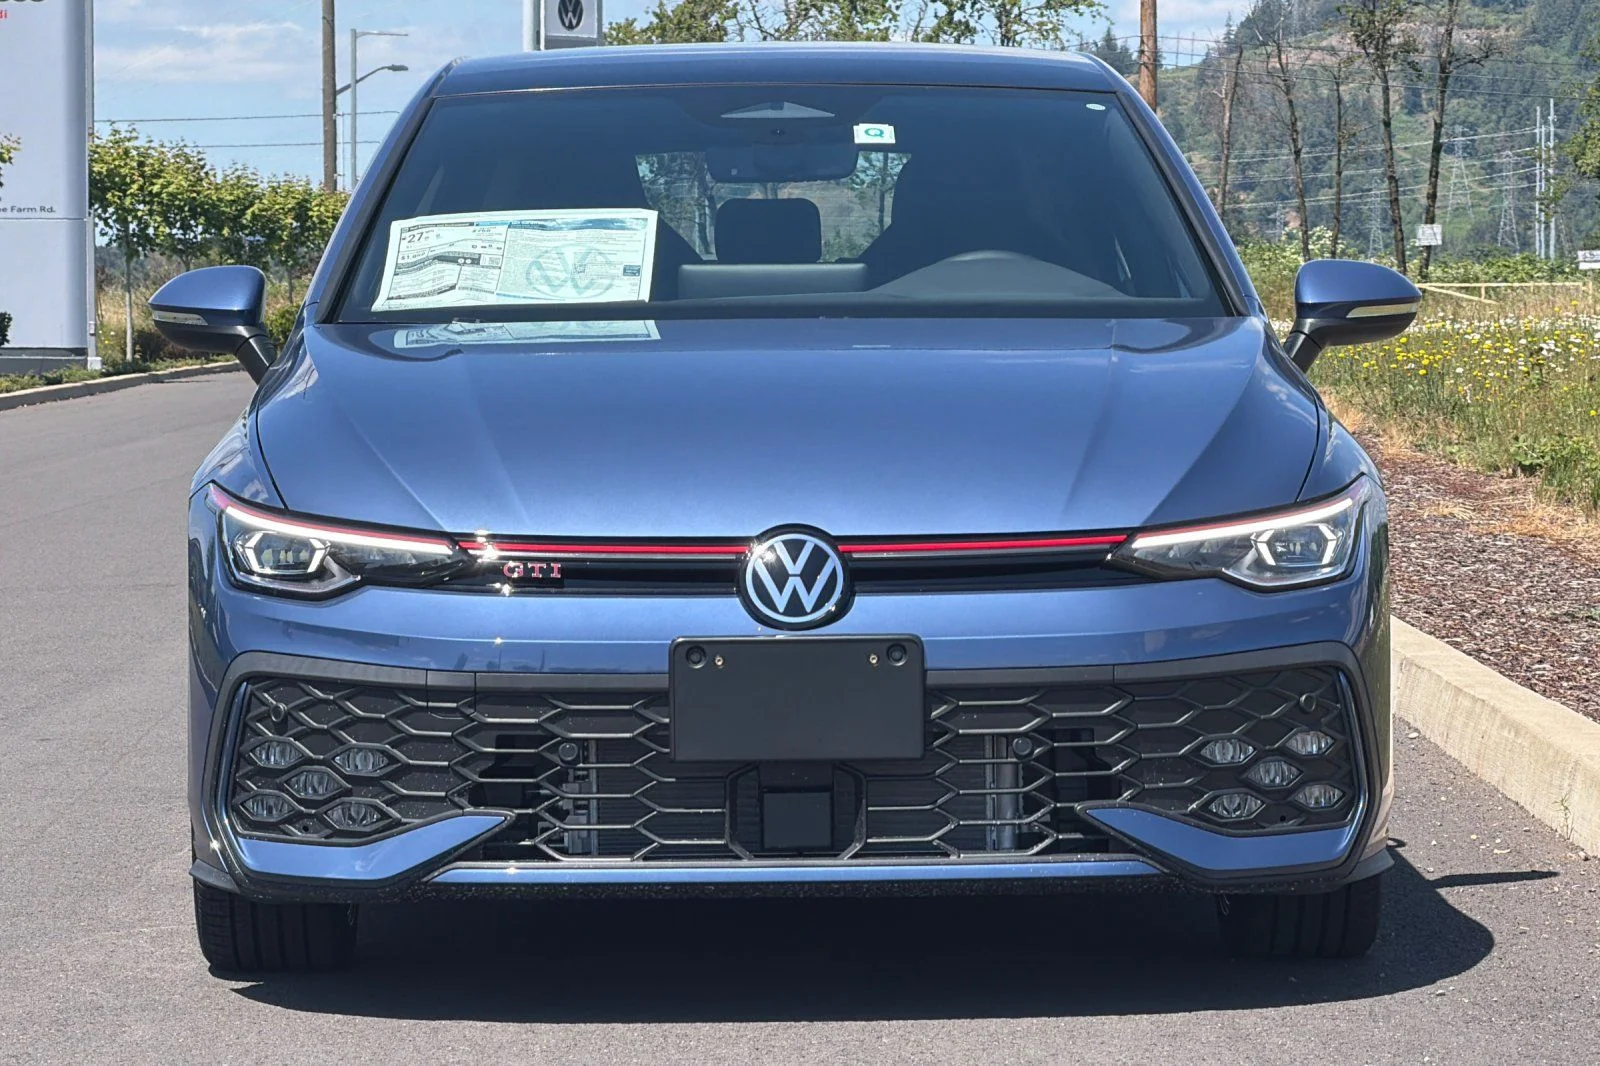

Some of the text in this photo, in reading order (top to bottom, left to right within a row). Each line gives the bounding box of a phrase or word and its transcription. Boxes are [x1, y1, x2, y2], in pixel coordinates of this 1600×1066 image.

[864, 127, 885, 138] Q
[10, 205, 37, 213] Farm
[39, 205, 56, 214] Rd.
[407, 231, 424, 243] 27
[503, 560, 562, 578] GTI
[749, 536, 841, 618] VW
